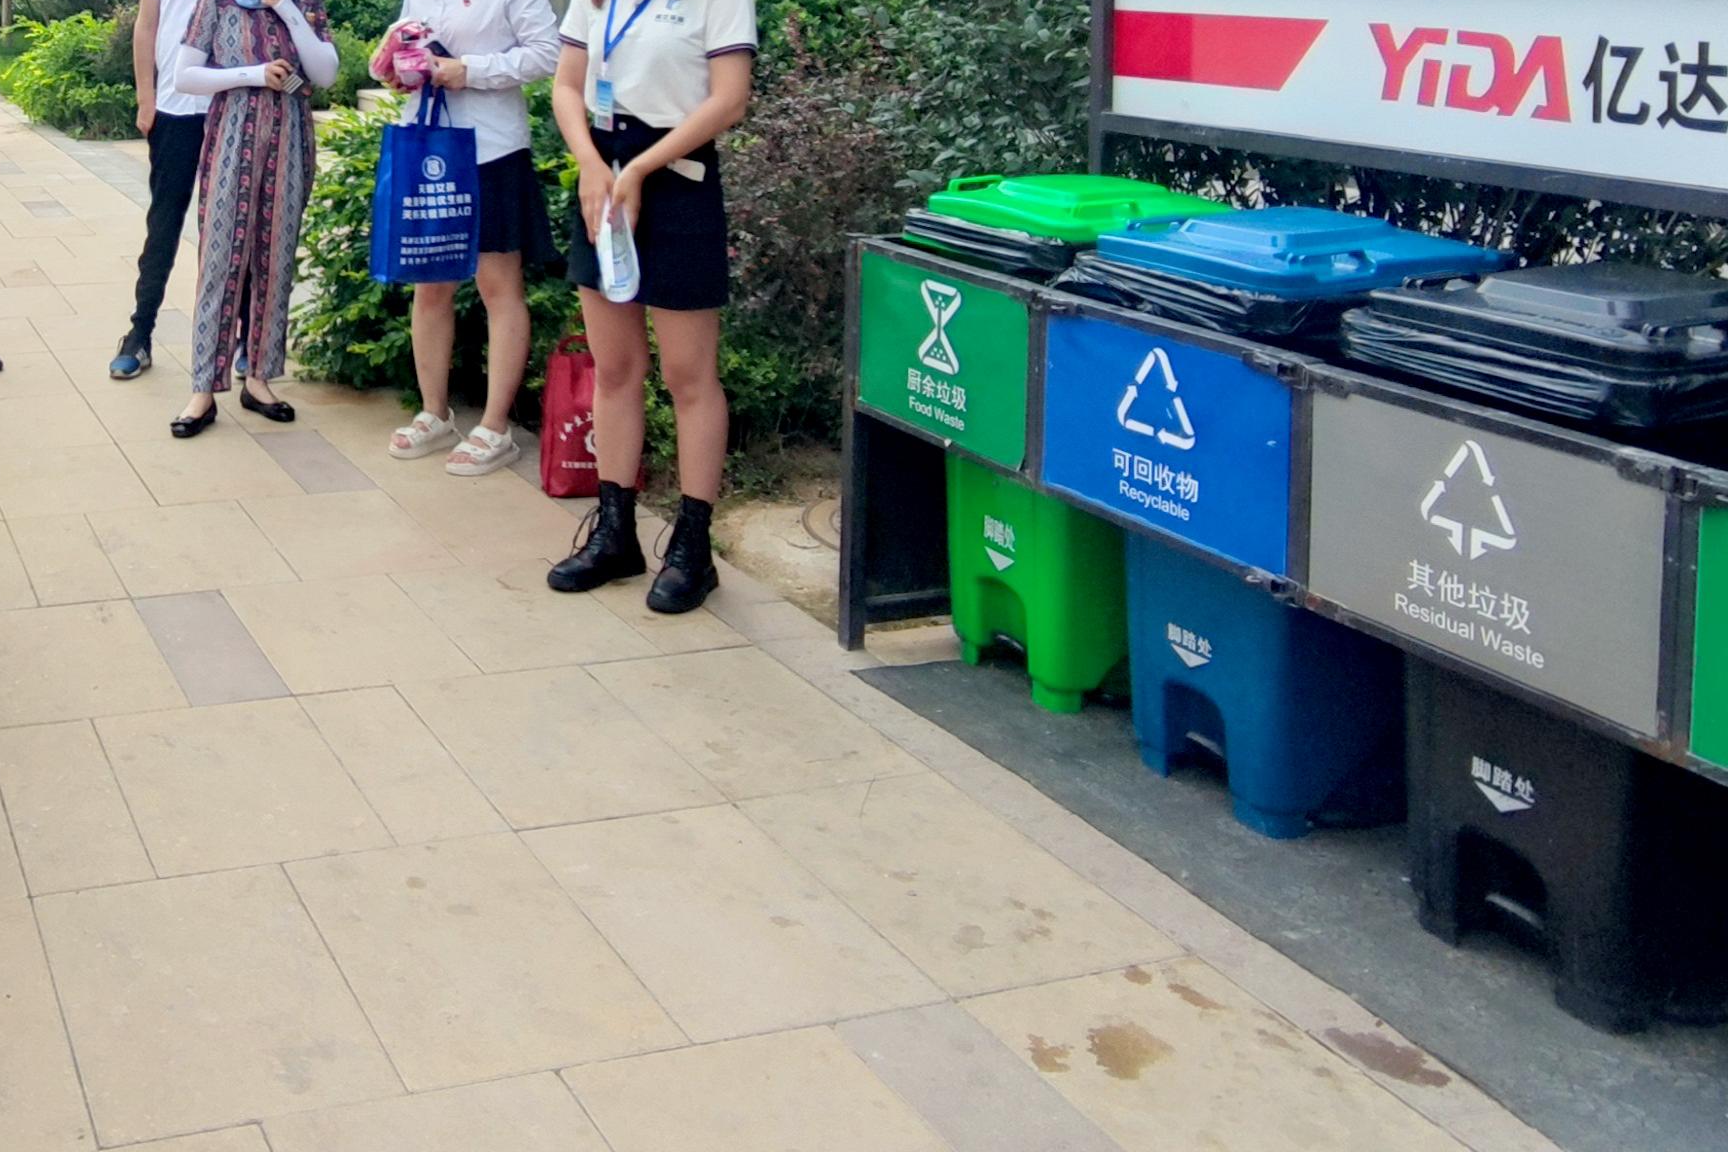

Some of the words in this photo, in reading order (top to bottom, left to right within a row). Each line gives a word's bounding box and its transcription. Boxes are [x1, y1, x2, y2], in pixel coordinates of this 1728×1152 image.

[1582, 34, 1728, 134] 亿达
[906, 367, 967, 413] 厨余垃圾
[908, 395, 932, 418] Food
[933, 405, 965, 432] Waste
[1112, 447, 1199, 504] 可回收物
[1119, 480, 1190, 522] Recyclable
[1406, 559, 1532, 636] 其他垃圾
[1394, 593, 1474, 641] Residual
[1480, 626, 1545, 669] Waste
[1472, 755, 1536, 805] 脚踏处
